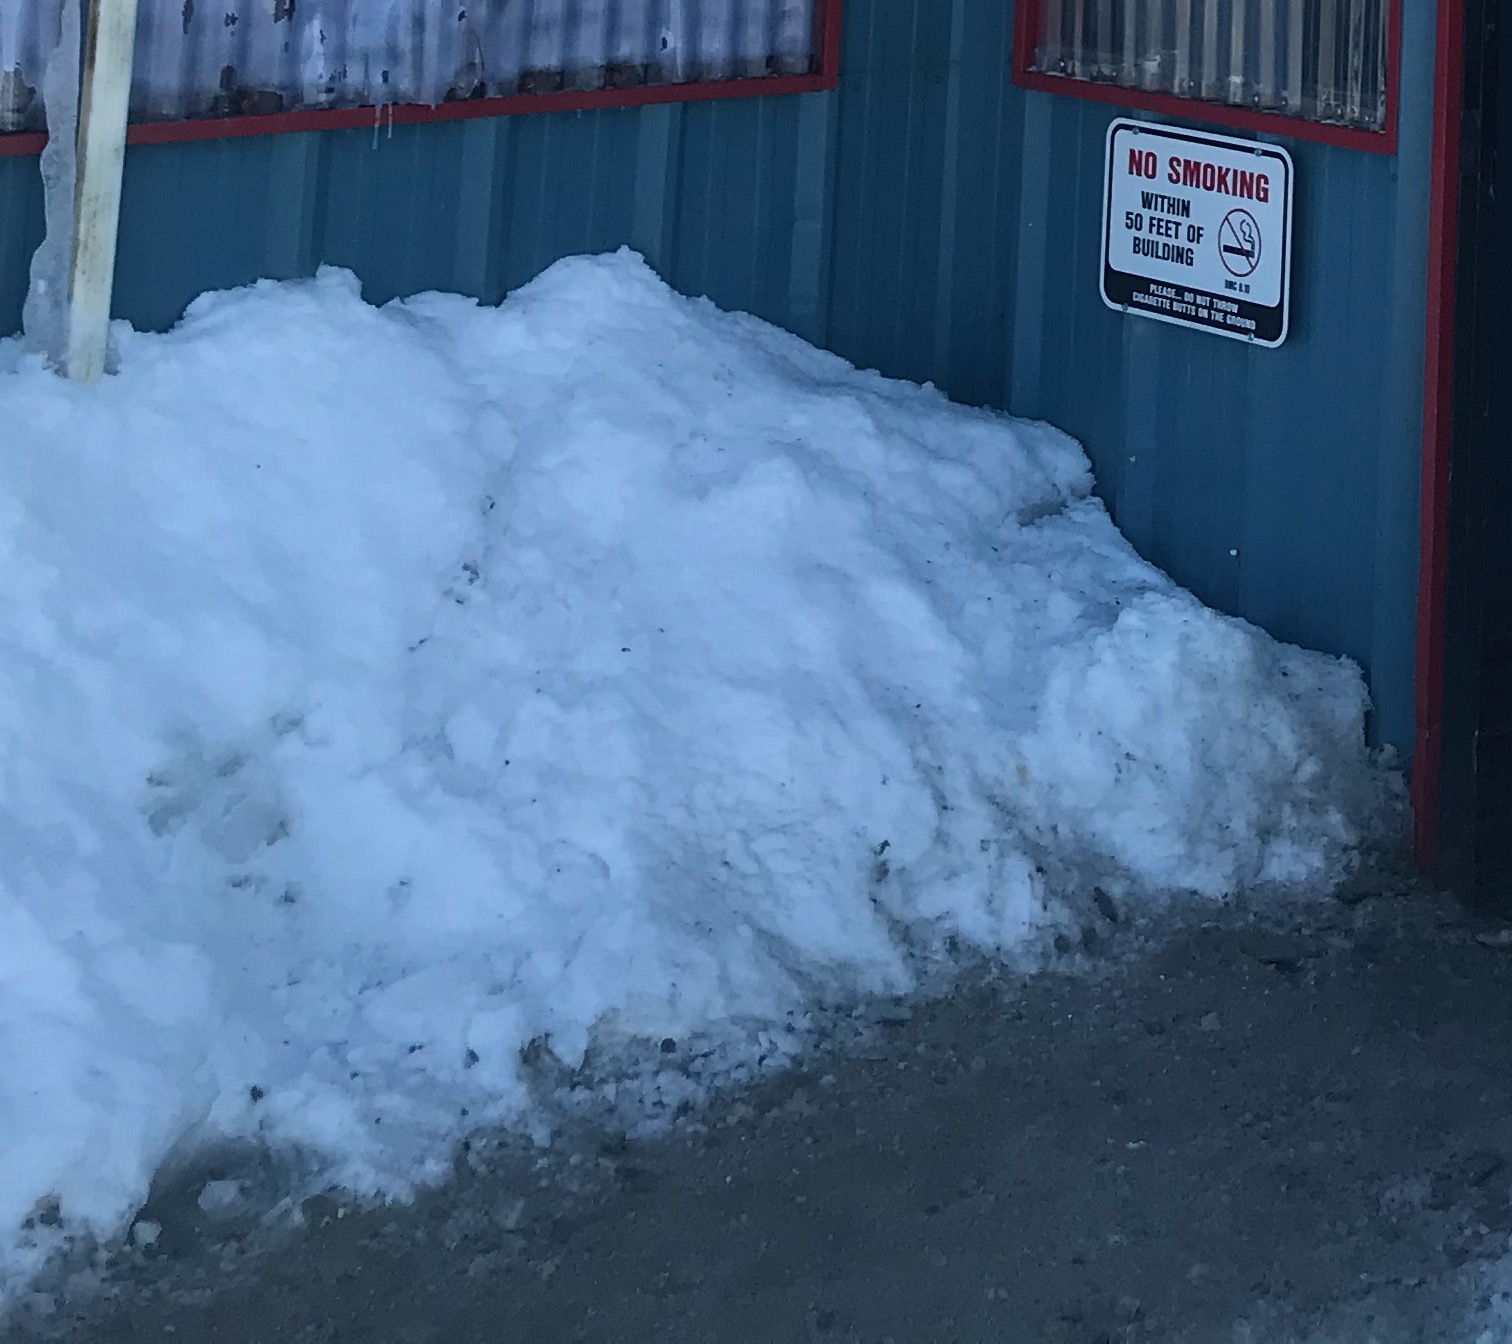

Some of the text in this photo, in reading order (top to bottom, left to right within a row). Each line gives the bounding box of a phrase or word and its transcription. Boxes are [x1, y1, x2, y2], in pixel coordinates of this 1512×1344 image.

[1128, 148, 1269, 203] NO SMOKING
[1141, 191, 1190, 218] WITHIN
[1125, 211, 1204, 244] 50 FEET OF
[1133, 236, 1194, 266] BUILDING
[1133, 292, 1256, 330] CIGARETTE BUTTS ON THE GROUND
[1184, 292, 1194, 303] DO
[1196, 294, 1211, 306] NOT
[1213, 298, 1239, 313] THROW
